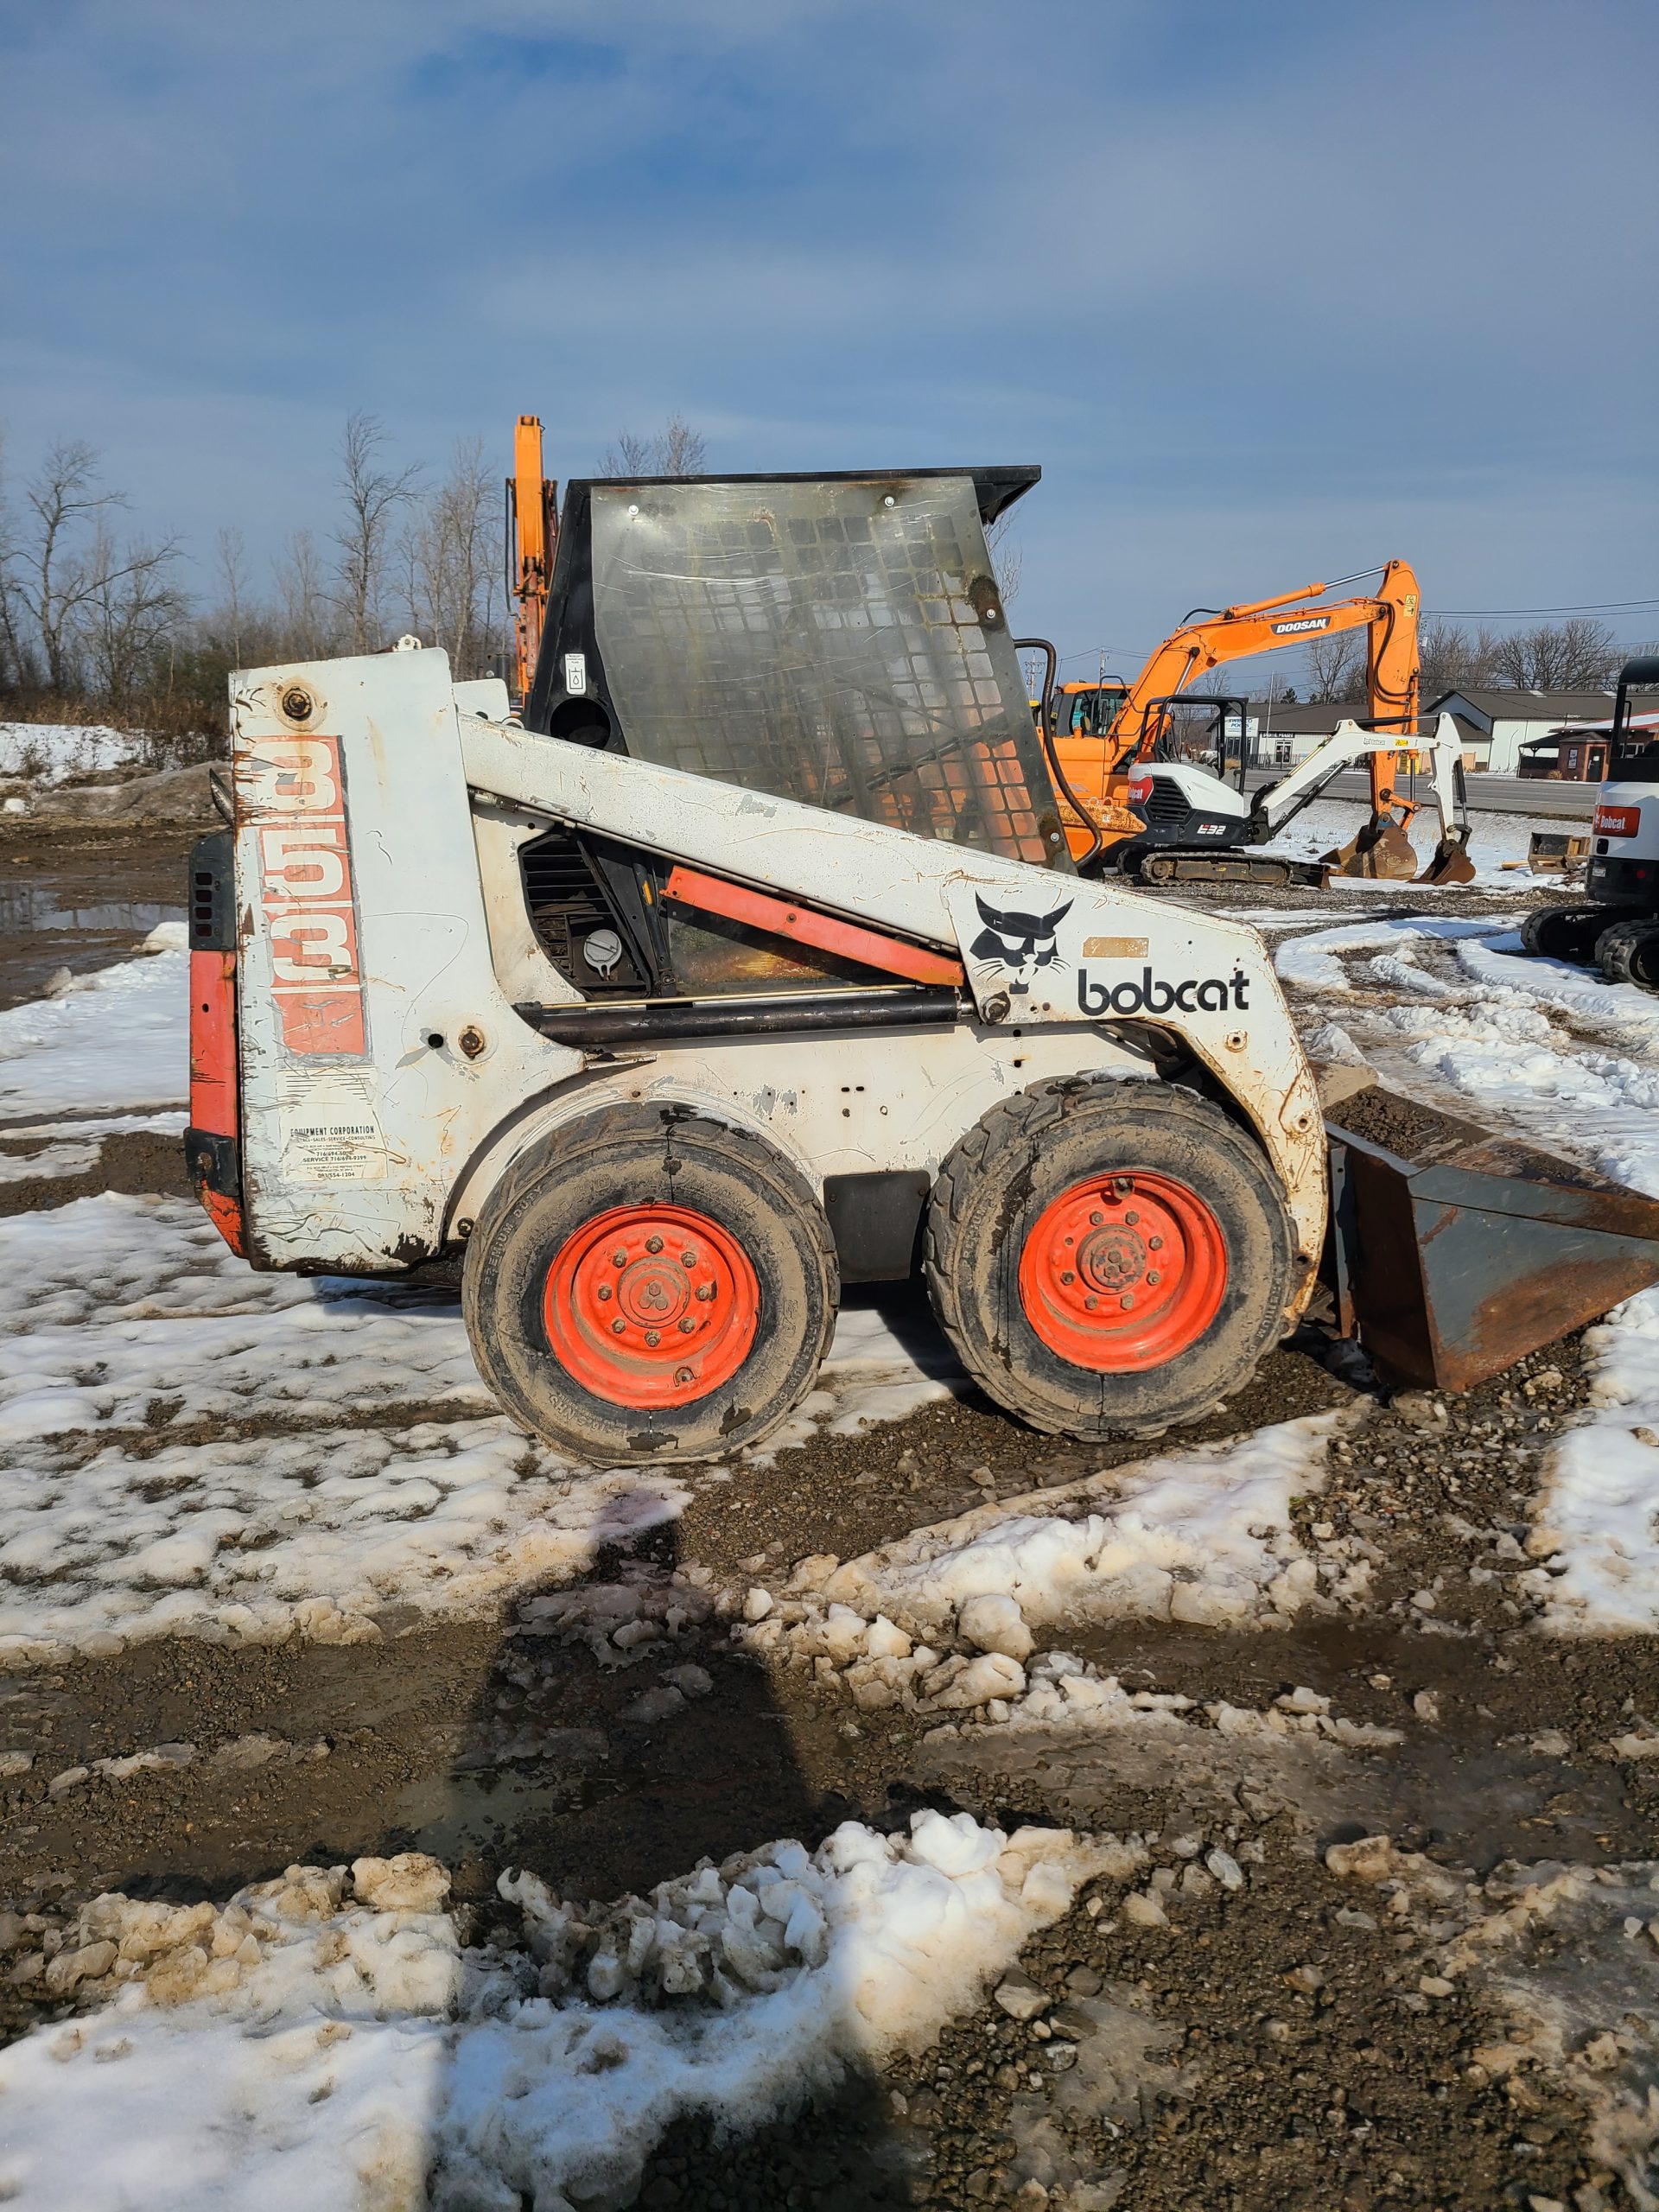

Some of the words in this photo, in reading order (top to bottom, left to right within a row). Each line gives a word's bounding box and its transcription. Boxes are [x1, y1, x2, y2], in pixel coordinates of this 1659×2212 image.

[1276, 619, 1326, 633] DOOSAN
[1197, 823, 1227, 836] E32
[1600, 816, 1626, 830] Bobcat
[251, 741, 353, 982] 853
[1077, 966, 1250, 1016] bobcat
[290, 1127, 327, 1137] EQUIPMENT
[330, 1125, 374, 1135] CORPORATION
[513, 1185, 543, 1219] DUTY
